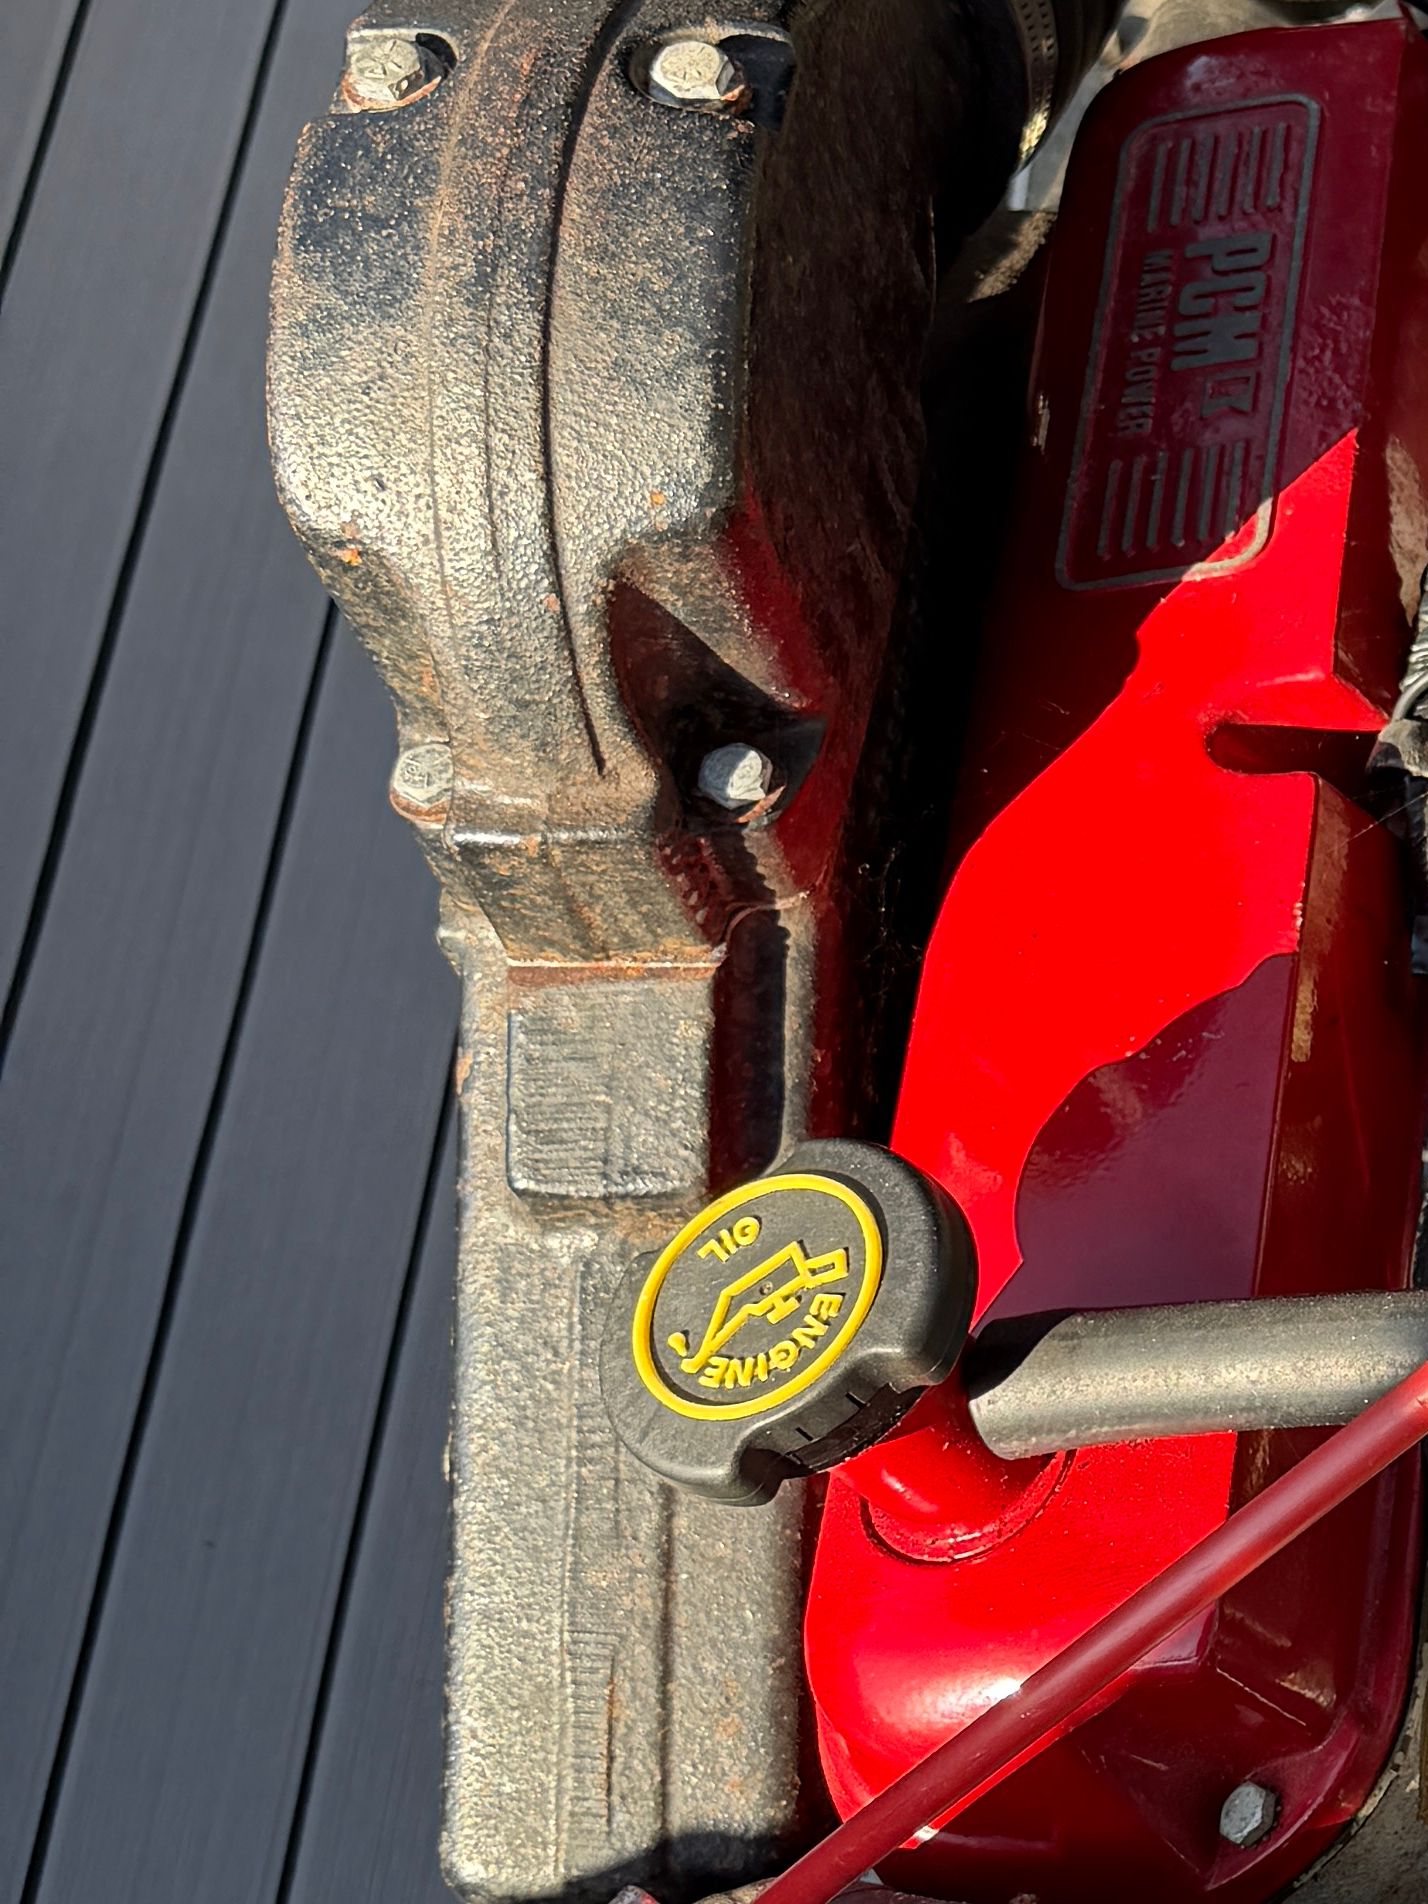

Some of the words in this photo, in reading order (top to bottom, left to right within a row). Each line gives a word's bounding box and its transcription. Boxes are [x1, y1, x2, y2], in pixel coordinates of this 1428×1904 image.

[1130, 249, 1174, 343] MARINE
[1171, 232, 1273, 372] PCM
[1117, 347, 1161, 437] POWER
[696, 1217, 760, 1264] OIL
[698, 1293, 843, 1388] ENGINE
